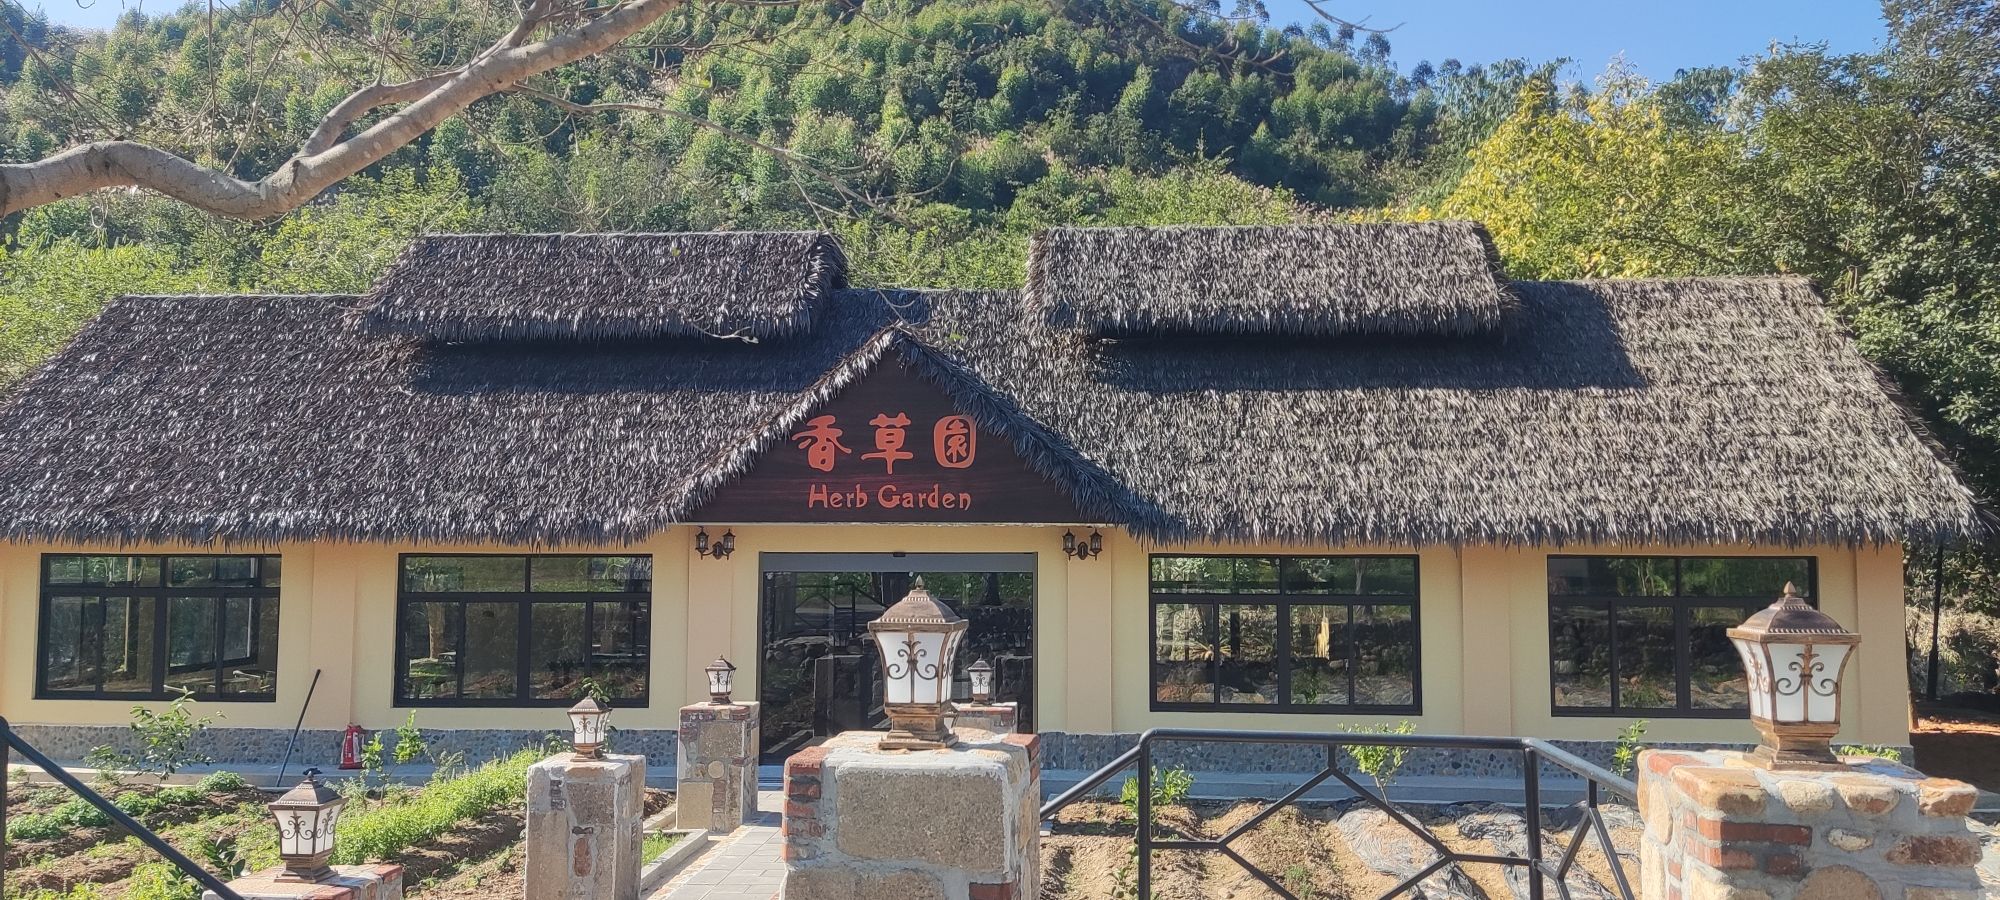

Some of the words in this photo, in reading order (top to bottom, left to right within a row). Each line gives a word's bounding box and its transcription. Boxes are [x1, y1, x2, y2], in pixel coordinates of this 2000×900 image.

[792, 412, 977, 474] 香草園
[808, 484, 868, 508] Herb
[876, 483, 972, 511] Garden
